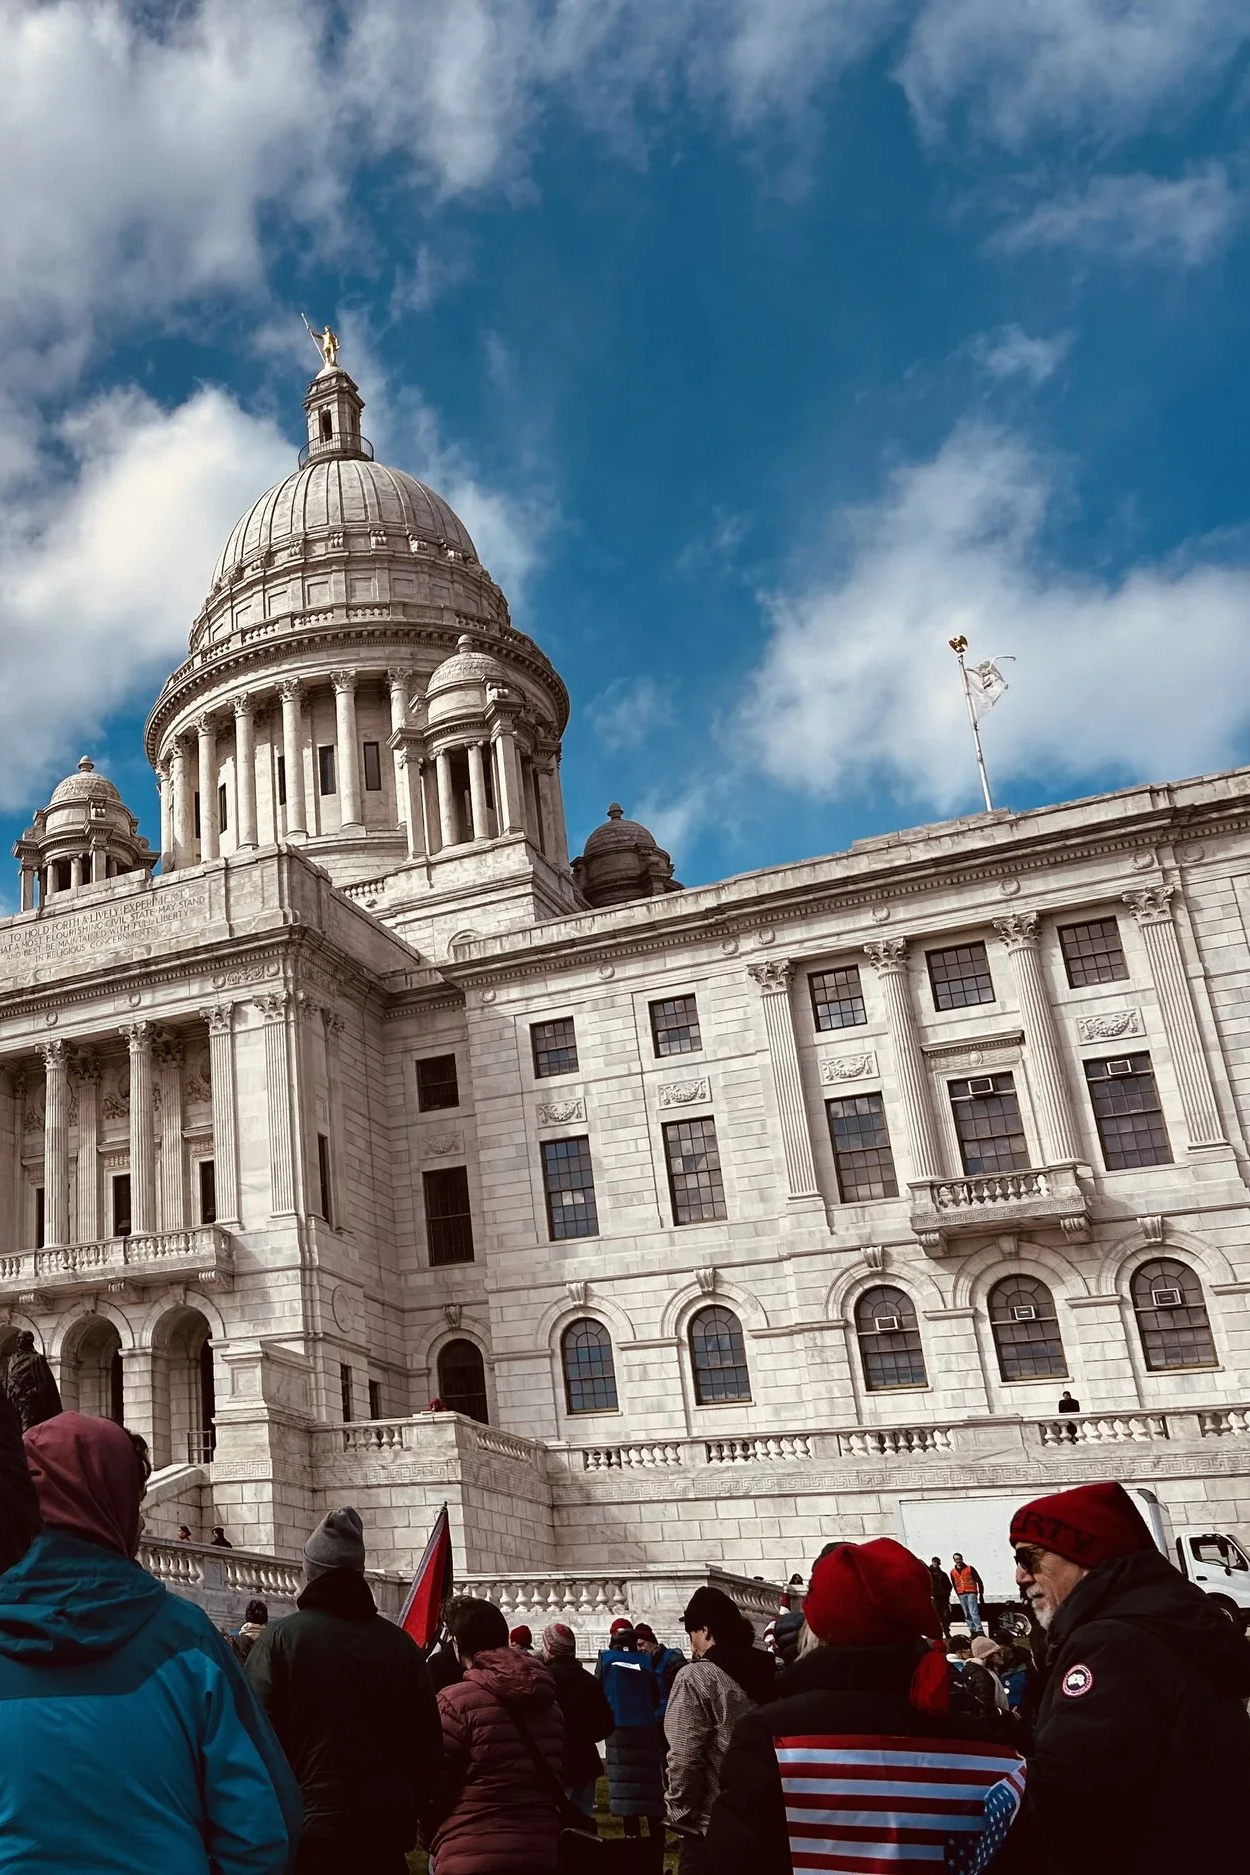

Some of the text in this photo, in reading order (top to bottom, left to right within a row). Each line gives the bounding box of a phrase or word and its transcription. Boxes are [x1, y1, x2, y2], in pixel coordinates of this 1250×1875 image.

[5, 910, 189, 961] AND BEST BE MAINTAINED WITH FULL LIBERTY
[9, 932, 22, 942] TO
[25, 925, 50, 940] HOLD
[52, 917, 80, 933] FORTH
[89, 907, 119, 924] LIVELY
[123, 889, 186, 914] EXPERIMENT
[22, 936, 42, 948] MOST
[46, 921, 103, 942] FLOURISHING
[105, 916, 127, 928] CIVIL
[130, 909, 154, 921] STATE
[158, 903, 177, 914] MAY
[178, 896, 205, 909] STAND
[47, 945, 86, 960] RELIGIOUS
